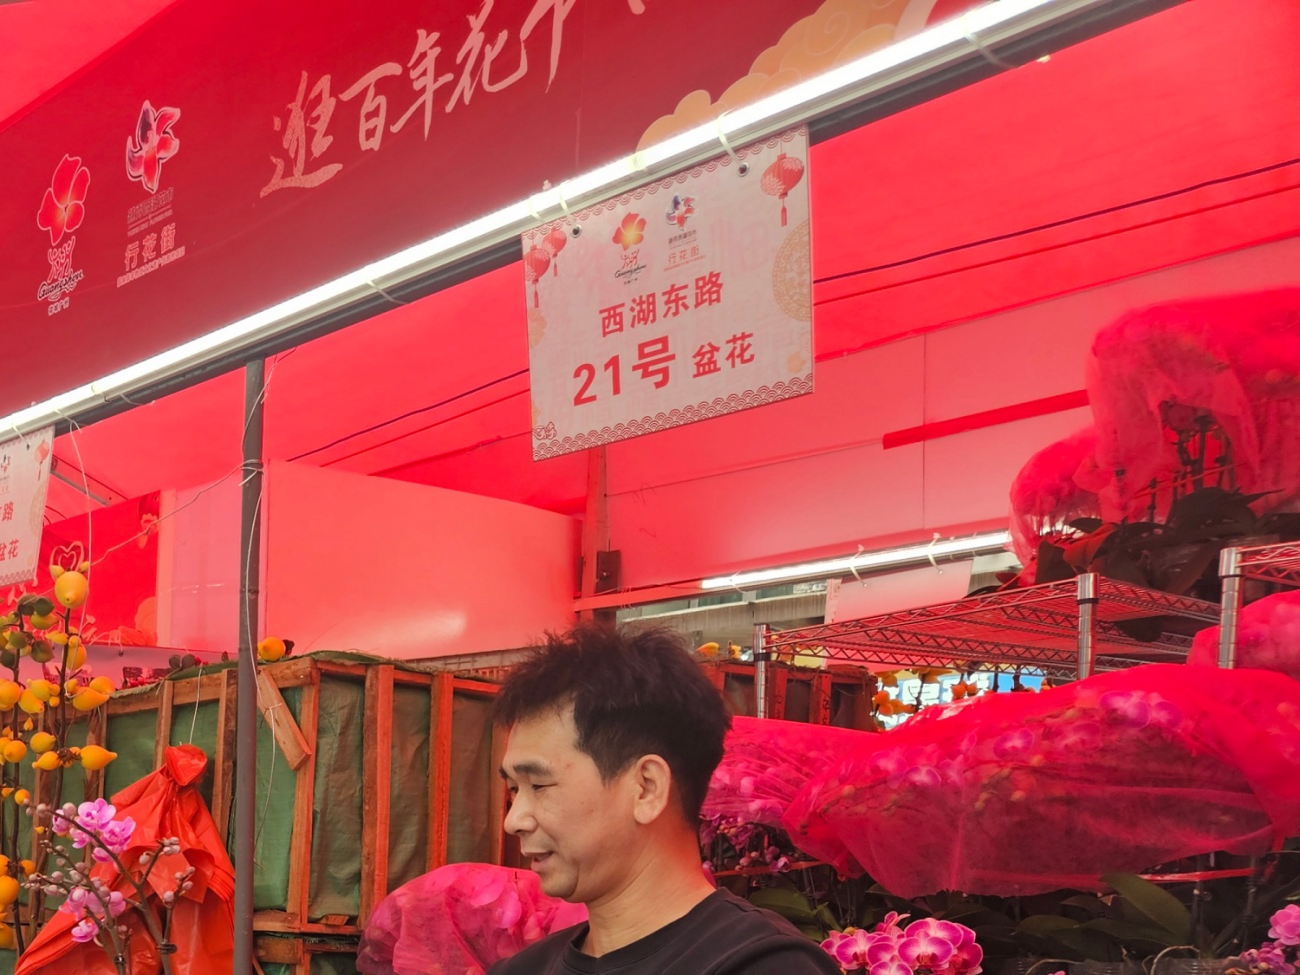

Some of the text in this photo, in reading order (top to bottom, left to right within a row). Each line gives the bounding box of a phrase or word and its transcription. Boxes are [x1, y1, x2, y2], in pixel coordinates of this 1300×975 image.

[124, 222, 176, 271] 行花街
[599, 270, 724, 338] 西湖东路
[573, 332, 755, 406] 21号 盆花
